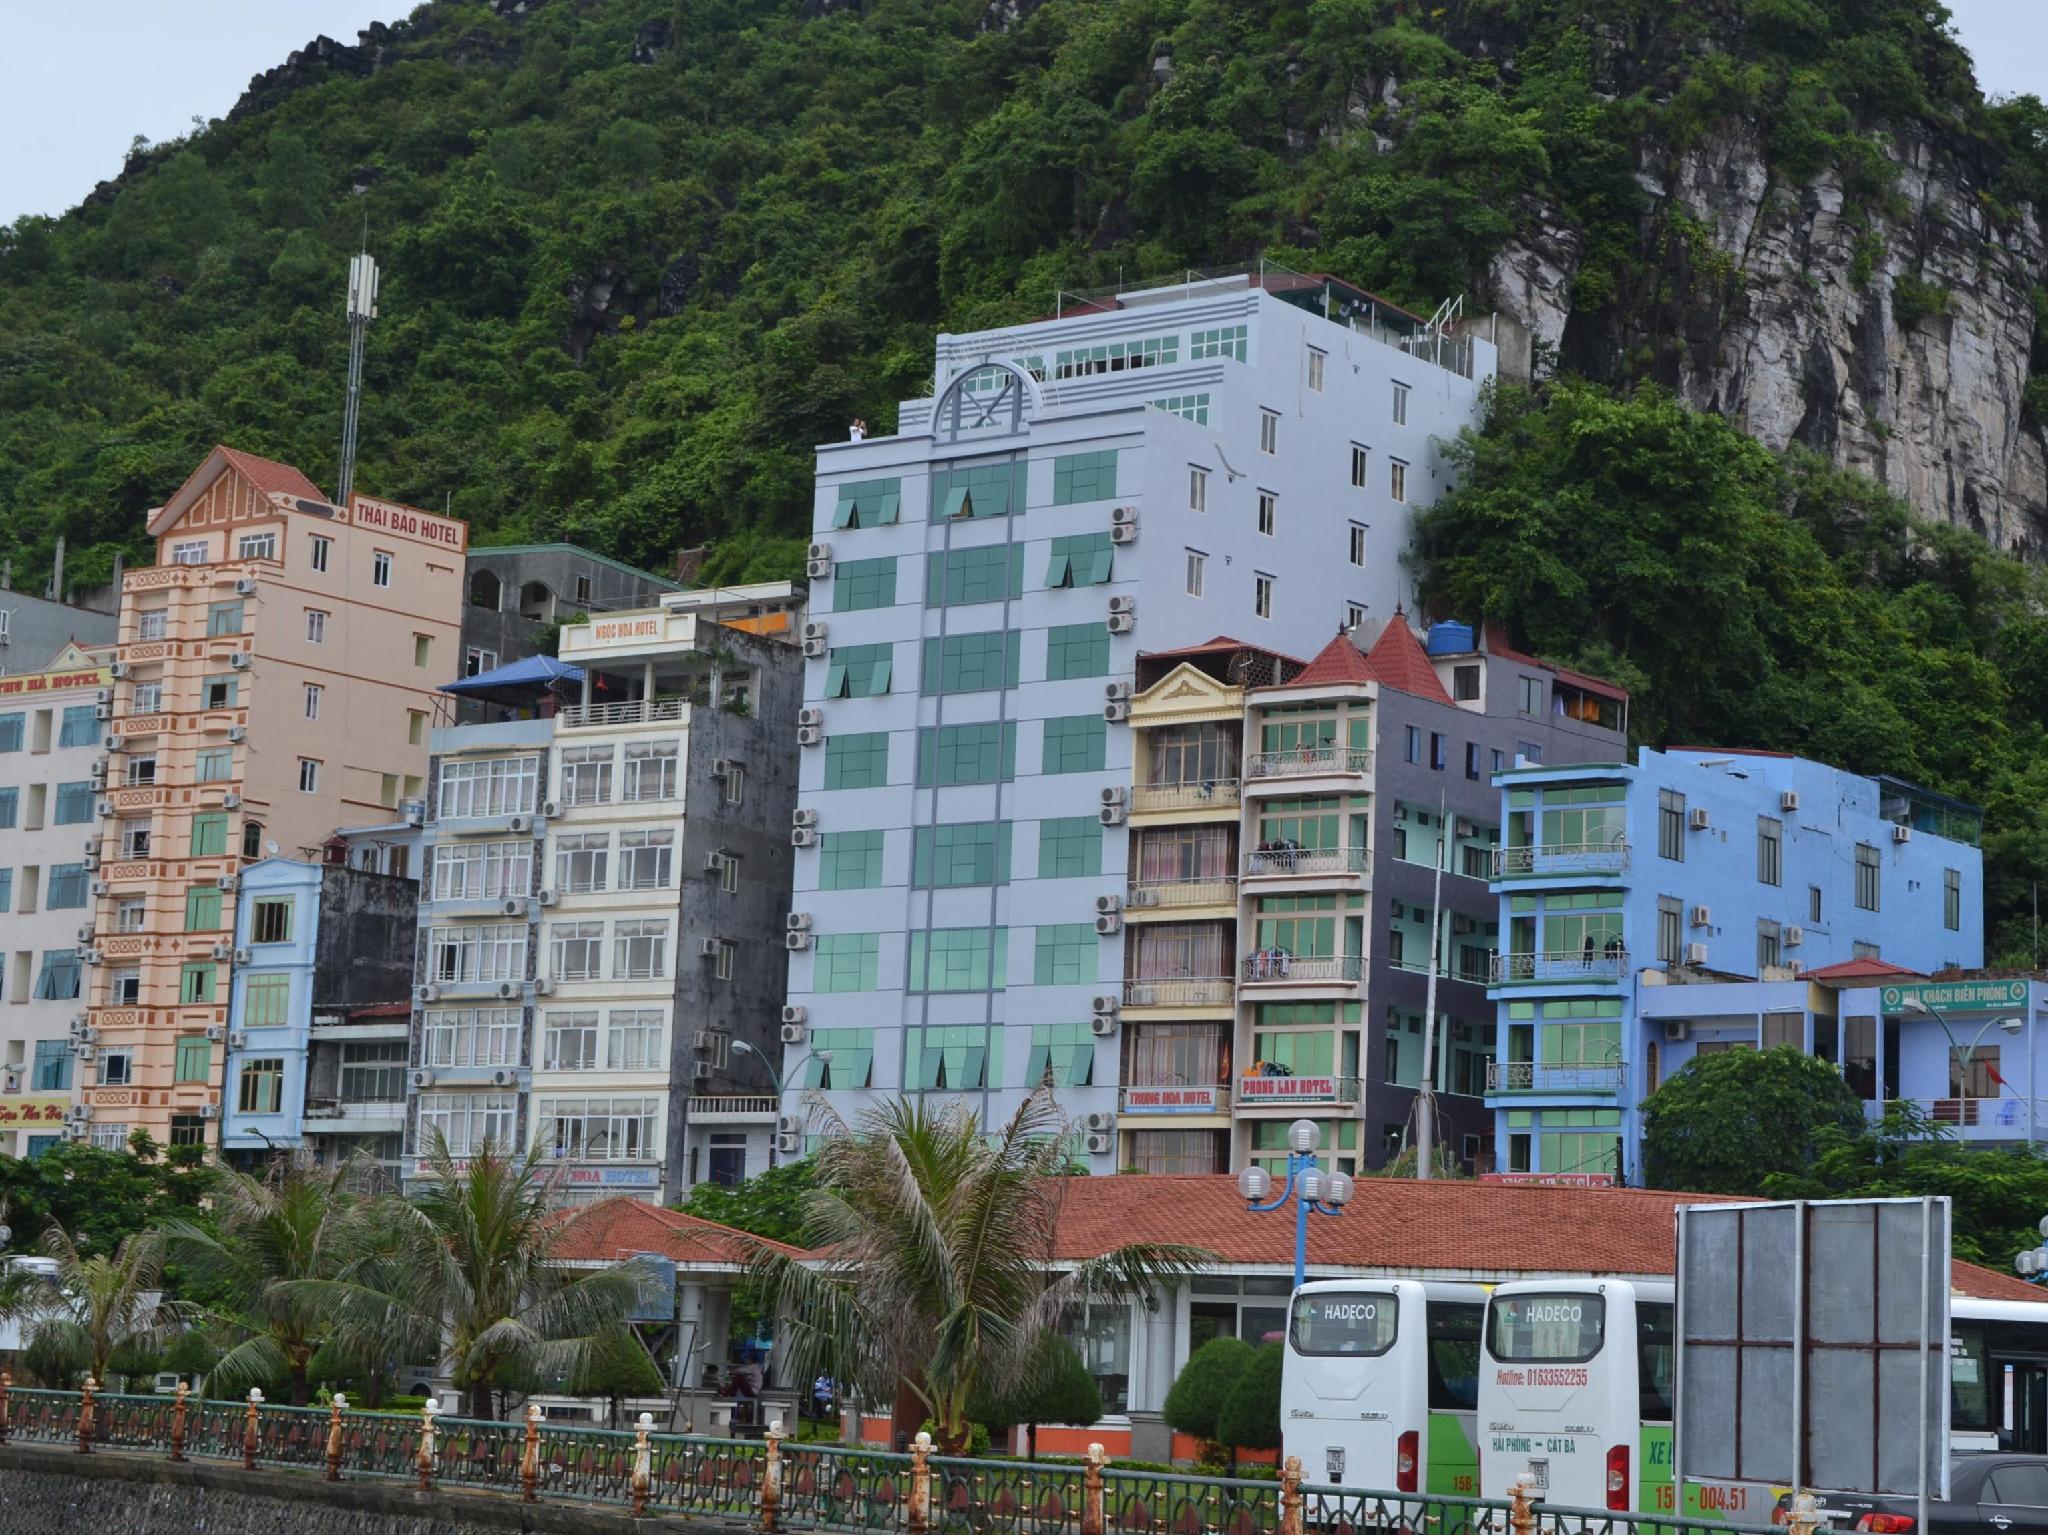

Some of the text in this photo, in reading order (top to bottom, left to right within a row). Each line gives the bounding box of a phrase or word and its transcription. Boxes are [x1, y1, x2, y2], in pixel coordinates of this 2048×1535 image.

[358, 504, 459, 545] THÁI BẢO HOTEL
[618, 622, 633, 638] HOA
[635, 620, 658, 637] HOTEL
[27, 674, 48, 691] HÀ
[52, 672, 100, 689] HOTEL
[1923, 986, 1952, 1003] KHÁCH
[1954, 985, 1976, 1002] BIÊN
[1977, 983, 2008, 1001] PHÒNG
[1243, 1079, 1332, 1095] PHONG LAN HOTEL
[1128, 1091, 1212, 1105] TRUNG HOA HOTEL
[570, 1169, 601, 1183] HOA
[605, 1169, 650, 1183] HOTEL
[1324, 1304, 1376, 1320] HADECO
[1526, 1305, 1582, 1323] HADECO
[1496, 1368, 1588, 1387] Hotline: 01633552255
[1506, 1434, 1531, 1453] PHÒNG
[1649, 1441, 1664, 1465] XE
[1453, 1475, 1472, 1491] 15B
[1656, 1486, 1675, 1509] 15
[1700, 1487, 1747, 1511] 004.51
